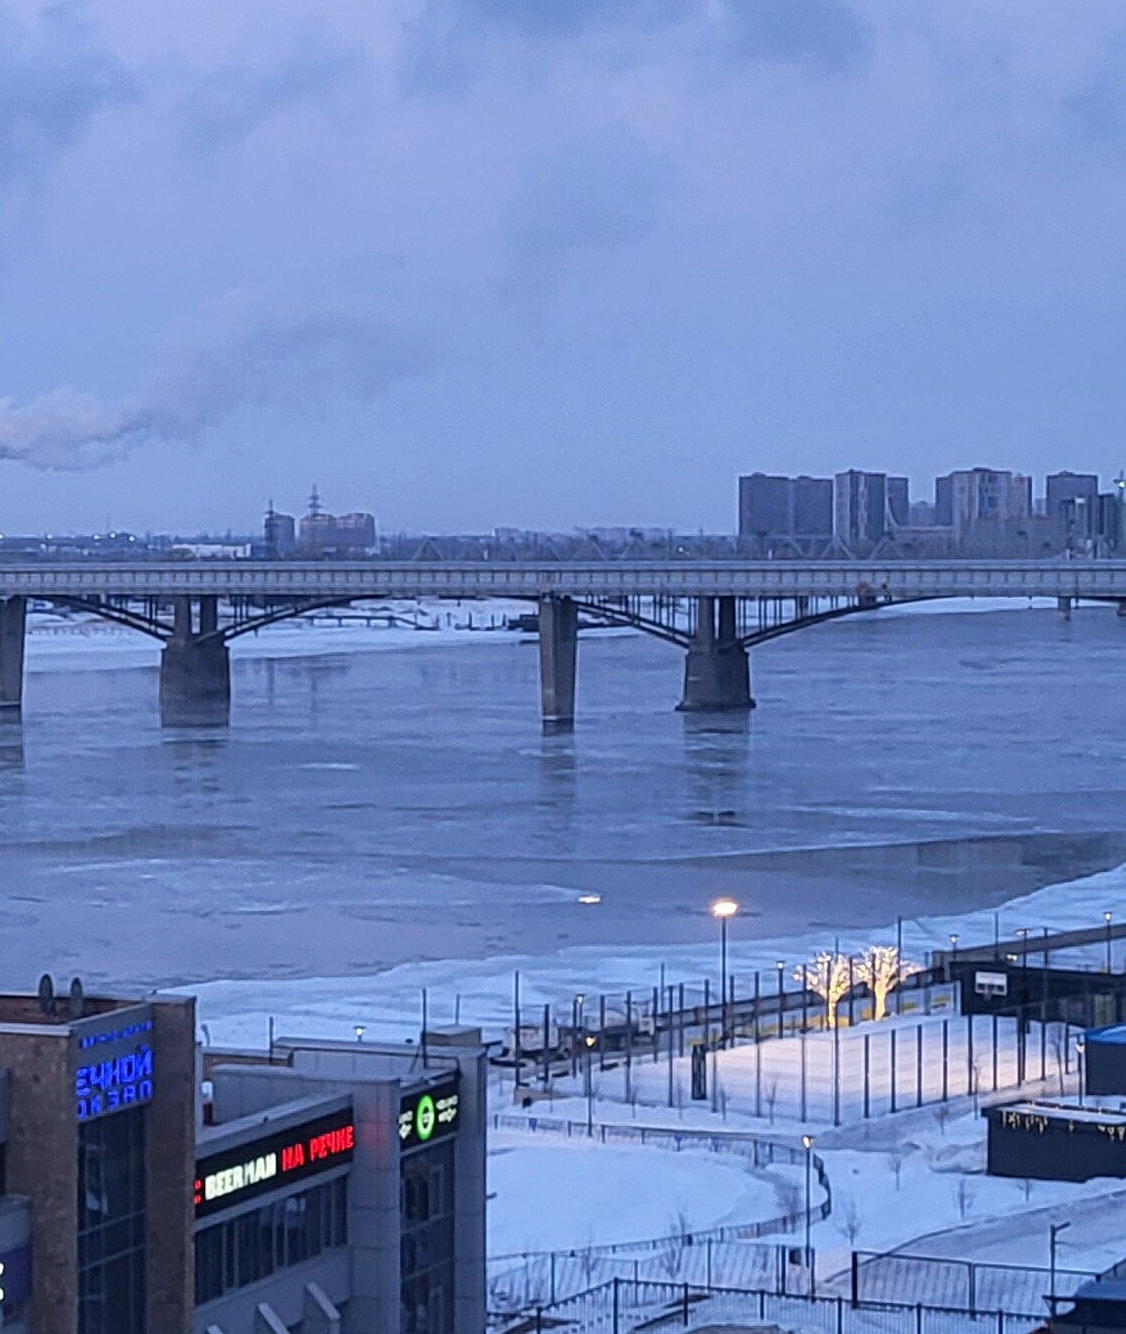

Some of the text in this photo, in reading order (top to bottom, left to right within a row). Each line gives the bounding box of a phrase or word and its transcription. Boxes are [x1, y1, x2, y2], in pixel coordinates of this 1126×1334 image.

[76, 1044, 153, 1097] ЕЧНОЙ
[76, 1079, 153, 1121] ОКЗАЛ
[205, 1153, 277, 1200] BEERMAN
[282, 1143, 304, 1172] НА
[310, 1125, 354, 1161] РЕЧКЕ
